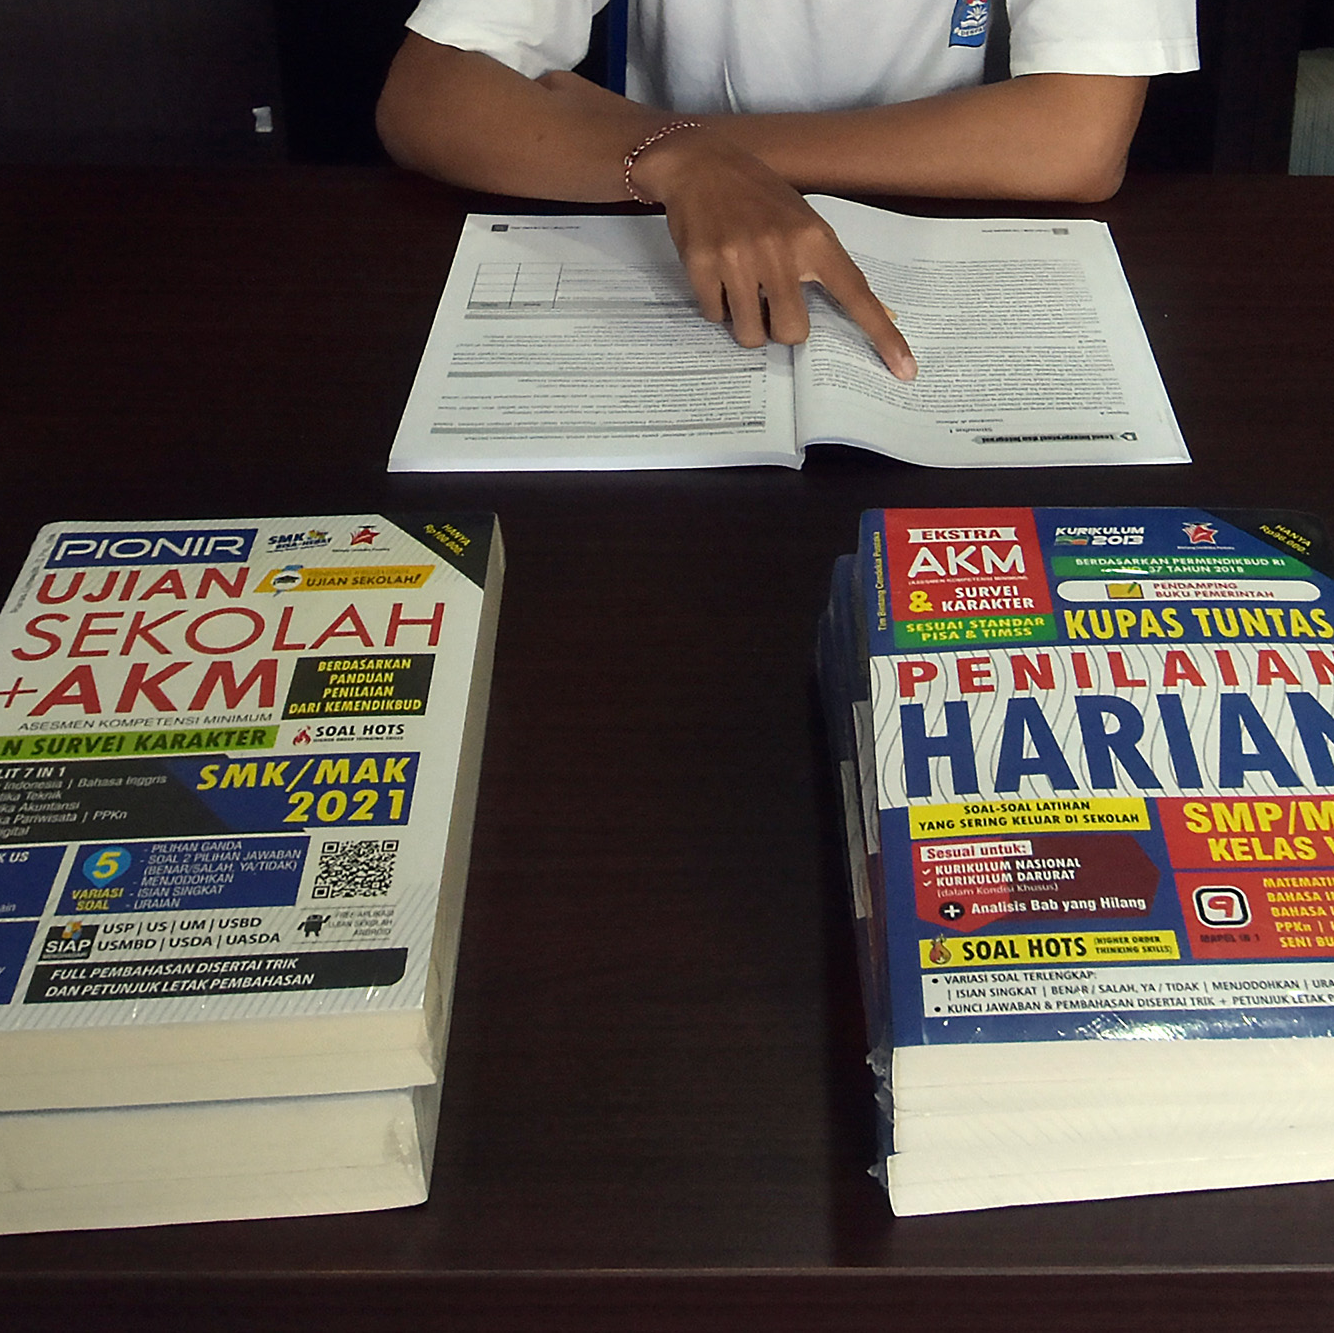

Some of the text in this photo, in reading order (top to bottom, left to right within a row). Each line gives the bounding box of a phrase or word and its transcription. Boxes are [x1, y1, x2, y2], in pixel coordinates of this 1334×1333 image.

[268, 531, 307, 546] SMK
[441, 523, 472, 547] HANYA
[922, 529, 1002, 541] EKSTRA
[1055, 526, 1145, 537] KURIKULUM
[1274, 524, 1312, 548] HANYA
[53, 535, 246, 561] PIONIR
[1091, 536, 1145, 546] 2013
[907, 544, 1026, 578] AKM
[1075, 557, 1269, 566] BERDASARKAN PERMENDIKBUD
[1166, 566, 1212, 574] TAHUN
[36, 567, 250, 605] UJIAN
[306, 577, 348, 587] UJIAN
[1153, 582, 1238, 590] PENDAMPING
[955, 585, 1019, 598] SURVEI
[1155, 590, 1275, 599] BUKU PEMERINTAH
[941, 598, 1035, 612] KARAKTER
[906, 618, 1045, 632] SESUAI STANDAR
[1064, 607, 1334, 640] KUPAS TUNTAS
[11, 602, 445, 662] SEKOLAH
[922, 627, 1032, 642] PISA TIMSS
[317, 659, 412, 672] BERDASARKAN
[329, 672, 394, 685] PANDUAN
[322, 686, 395, 699] PENILAIAN
[288, 699, 423, 715] DARI KEMENDIKBUD
[18, 712, 274, 733] ASESMEN KOMPETENSI MINIMUM
[315, 724, 405, 738] SOAL HOTS
[30, 734, 123, 756] SURVEI
[133, 729, 268, 752] KARAKTER
[196, 757, 411, 793] SMK/MAK
[282, 789, 407, 825] 2021
[964, 801, 1090, 815] SOAL-SOAL LATIHAN
[919, 813, 1139, 832] YANG SERING KELUAR SEKOLAH
[151, 840, 243, 854] PILIHAN GANDA
[1208, 836, 1317, 862] KELAS
[11, 852, 29, 863] US
[149, 849, 302, 866] SOAL PILIHAN JAWABAN
[91, 851, 122, 880] 5
[935, 857, 1081, 876] KURIKULUM NASIONAL
[140, 873, 234, 887] MENJODOHKAN
[936, 869, 1076, 887] KURIKULUM DARURAT
[72, 887, 124, 901] VARIASI
[137, 884, 224, 899] ISIAN SINGKAT
[75, 899, 110, 911] SOAL
[134, 898, 181, 910] URAIAN
[971, 897, 1147, 915] Analisis Bab yang Hilang
[44, 939, 92, 954] SIAP
[962, 936, 1088, 962] SOAL HOTS
[50, 958, 299, 982] FULL PEMBAHASAN DISERTAI TRIK
[45, 973, 315, 998] DAN PETUNJUK LETAK PEMBAHASAN
